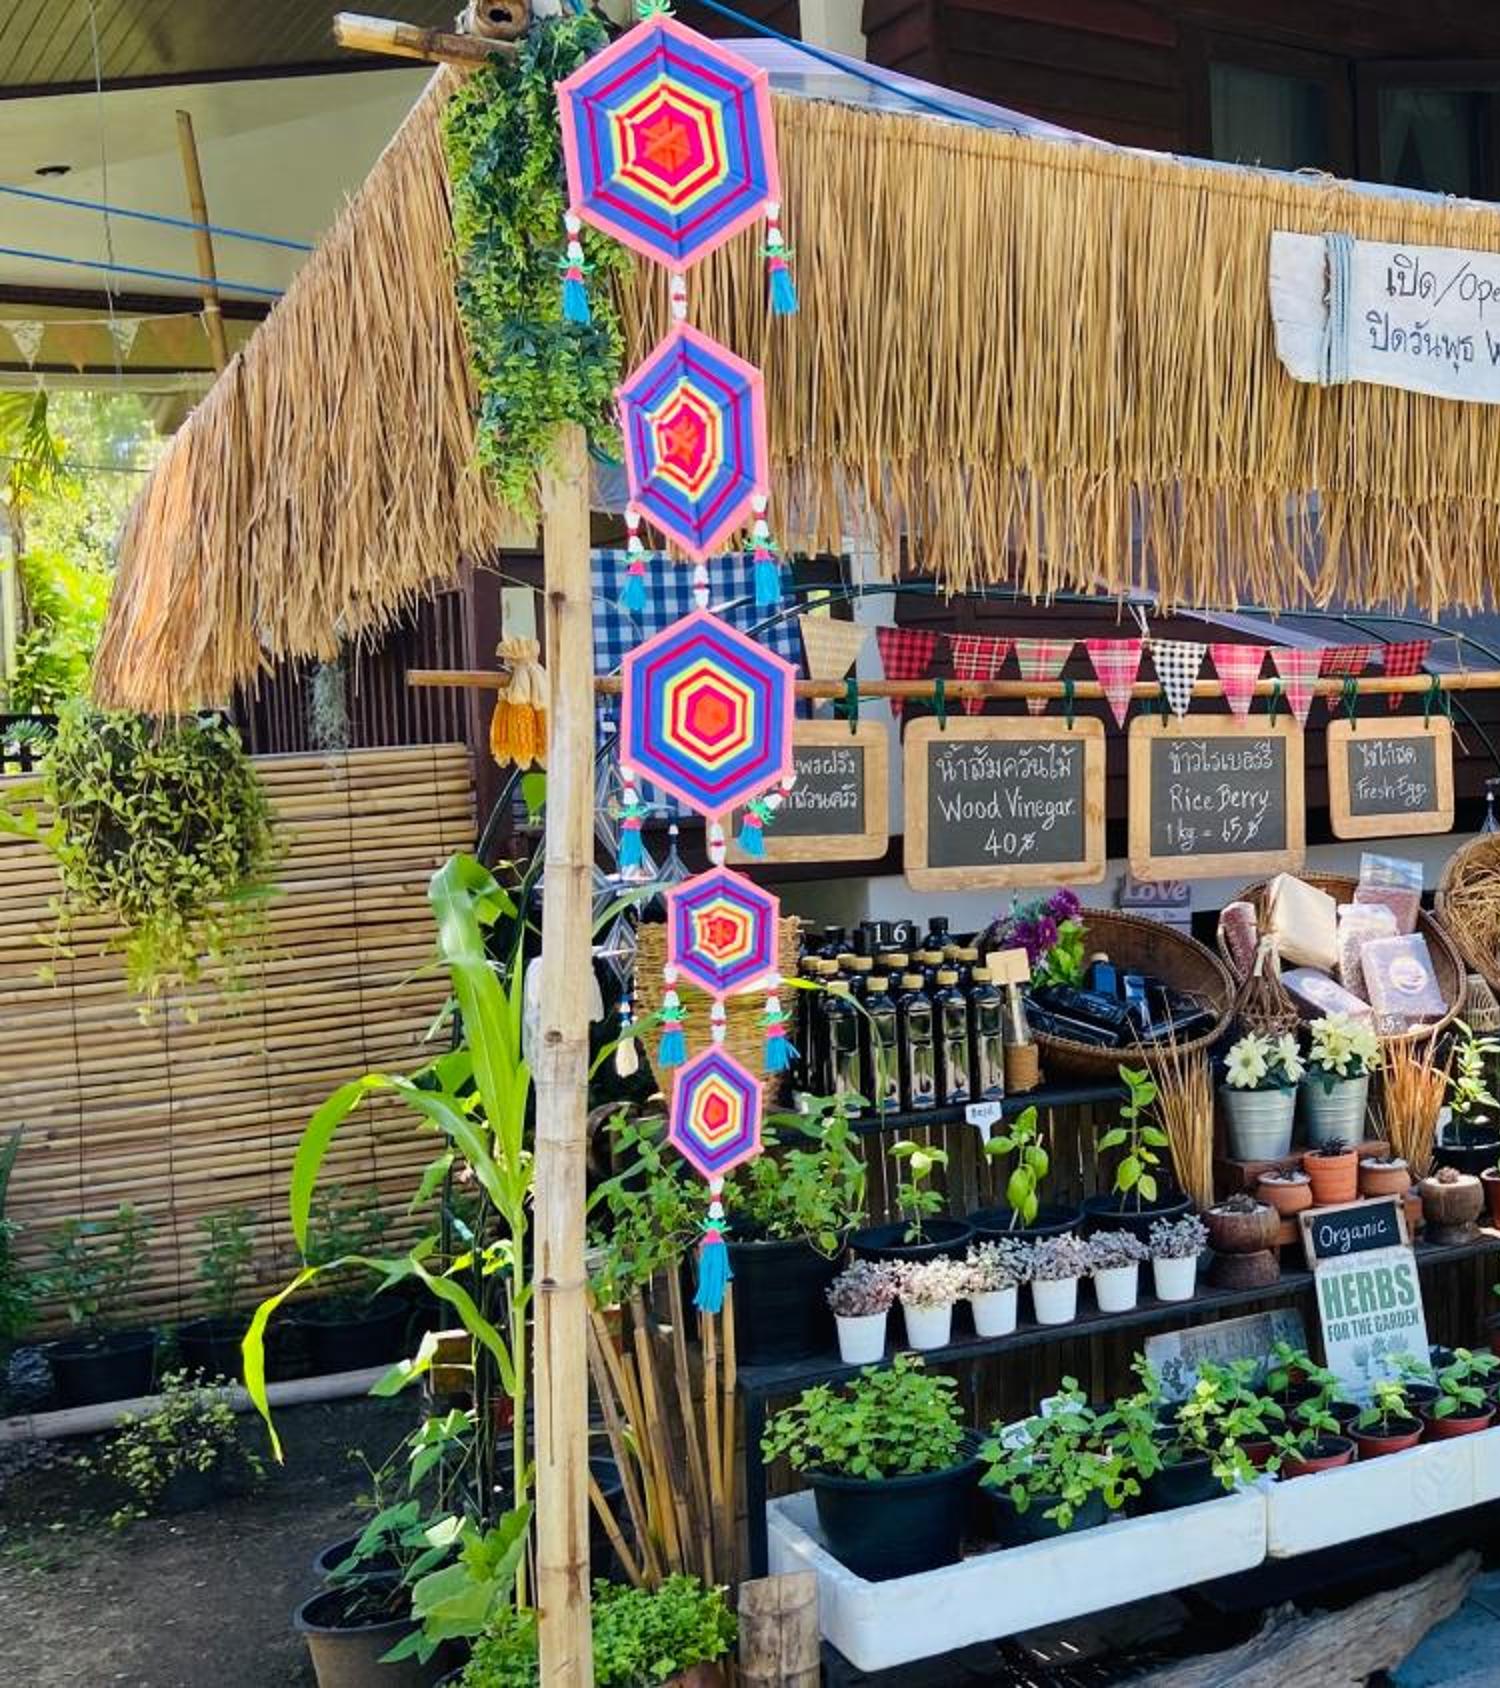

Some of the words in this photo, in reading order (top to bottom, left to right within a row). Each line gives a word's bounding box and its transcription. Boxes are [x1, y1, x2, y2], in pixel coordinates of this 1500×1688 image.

[1366, 311, 1474, 374] ปิดวันพุธ
[936, 743, 1076, 782] น้ำส้มควันไม้
[1169, 783, 1214, 812] Rice
[1356, 776, 1395, 800] Fresh
[937, 790, 1002, 822] Wood
[1320, 1218, 1387, 1253] Organic
[1321, 1263, 1416, 1320] HERBS
[1327, 1321, 1351, 1342] FOR
[1351, 1315, 1373, 1337] THE
[1375, 1309, 1420, 1334] GARDEN
